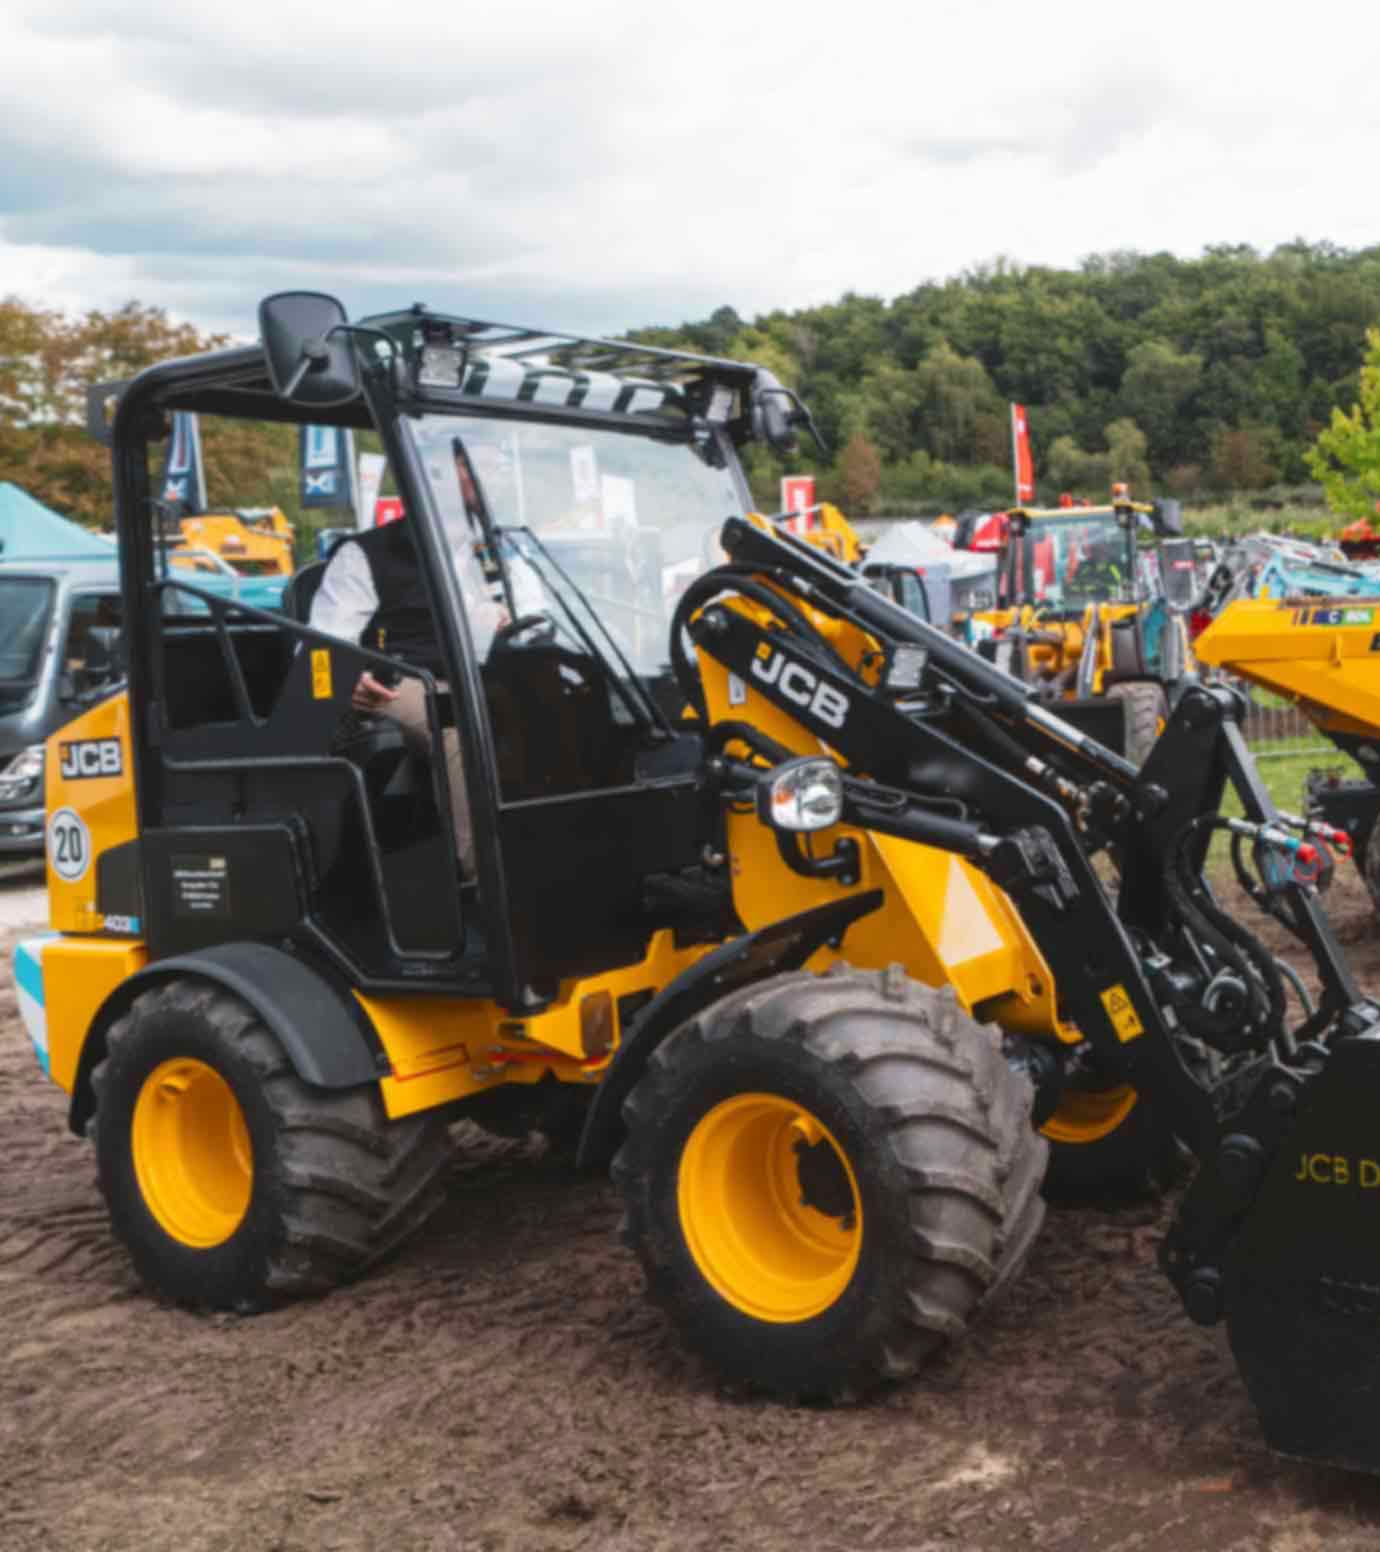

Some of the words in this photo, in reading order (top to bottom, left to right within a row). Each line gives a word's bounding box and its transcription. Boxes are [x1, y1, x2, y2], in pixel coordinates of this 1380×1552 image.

[752, 641, 850, 729] JCB
[60, 740, 121, 778] JCB
[55, 826, 83, 862] 20
[1295, 1153, 1350, 1185] JCB
